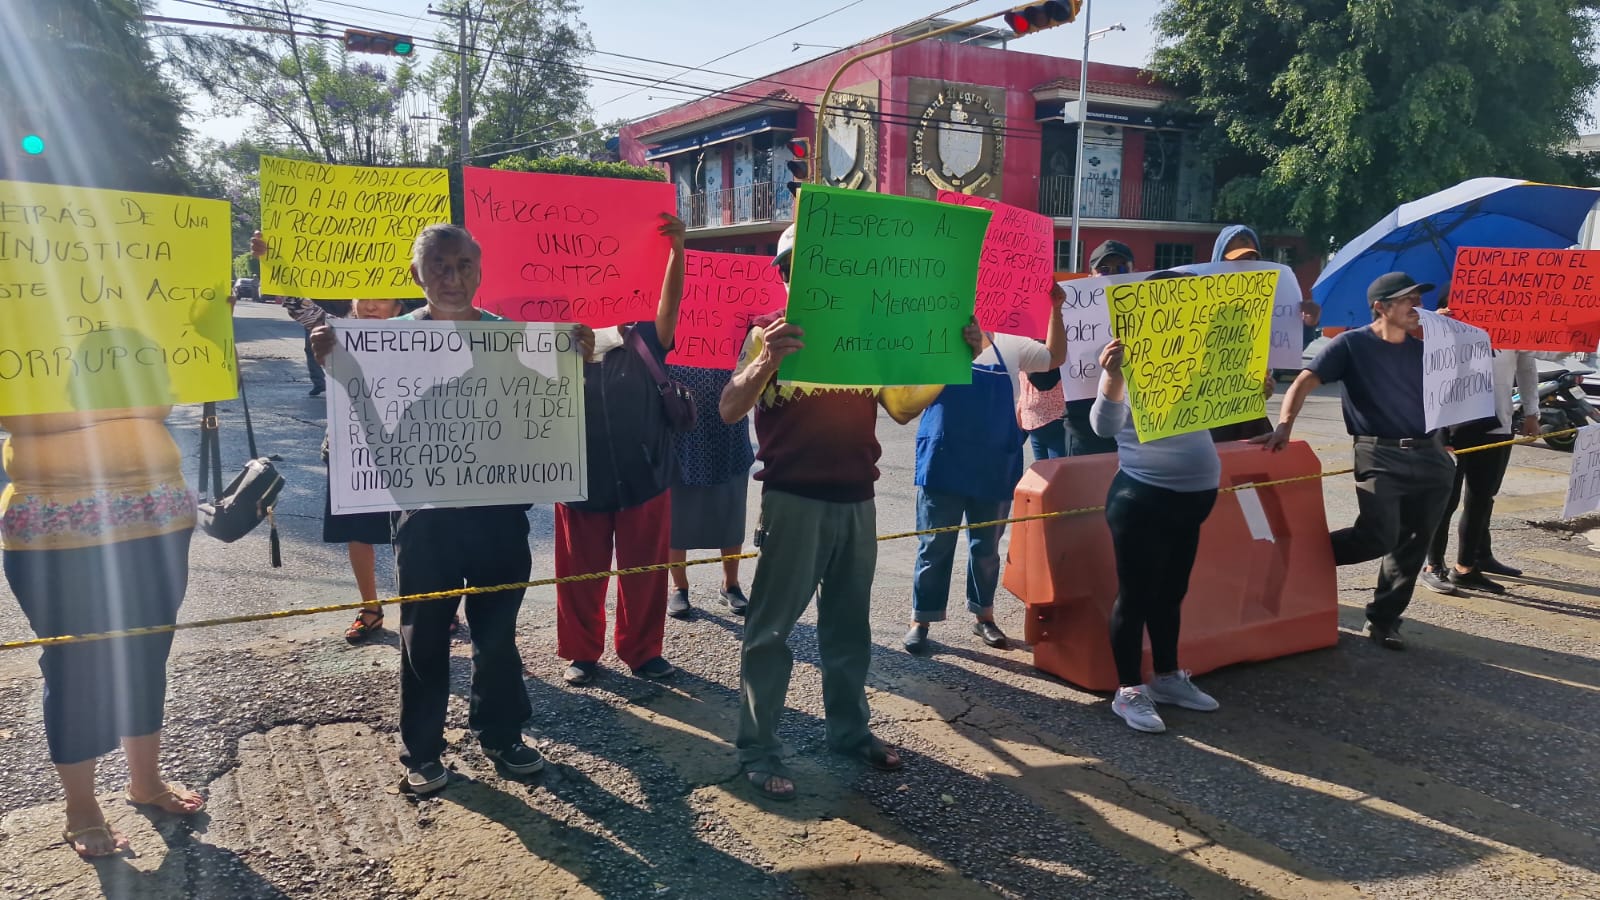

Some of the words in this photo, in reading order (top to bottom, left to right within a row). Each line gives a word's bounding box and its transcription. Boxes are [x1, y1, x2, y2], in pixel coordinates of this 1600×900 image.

[264, 180, 297, 207] ALTO
[308, 187, 322, 209] A
[327, 189, 348, 212] LA
[353, 189, 450, 215] CORRUPCION
[471, 186, 600, 226] MERCADO
[0, 201, 97, 229] ETRÁS
[115, 198, 155, 226] DE
[174, 203, 209, 230] UNA
[801, 191, 914, 239] RESPETO
[933, 212, 959, 240] AL
[0, 231, 171, 265] INJUSTICIA
[264, 236, 284, 261] AL
[536, 232, 621, 258] UNIDO
[986, 227, 1030, 251] LAMENTO
[683, 253, 785, 286] ERCADO
[800, 243, 946, 279] REGLAMENTO
[1000, 248, 1051, 275] RESPETO
[1457, 249, 1530, 268] CUMPLIR
[1536, 251, 1564, 267] CON
[1568, 252, 1588, 268] EL
[364, 266, 385, 288] YA
[388, 266, 412, 288] BA
[520, 262, 622, 286] CONTRA
[1200, 271, 1277, 301] REGIDORES
[1455, 268, 1566, 291] REGLAMENTO
[1571, 274, 1595, 291] DE
[0, 282, 48, 299] STE
[80, 275, 122, 304] UN
[146, 278, 217, 303] ACTO
[975, 290, 1006, 307] ENTO
[1010, 291, 1031, 310] DE
[1451, 289, 1533, 307] MERCADOS
[800, 287, 848, 312] DE
[870, 288, 961, 318] MERCADOS
[59, 315, 112, 337] DE
[679, 308, 723, 329] MAS
[974, 306, 1021, 328] CADOS
[1115, 310, 1146, 339] HAY
[1151, 307, 1185, 335] QUE
[1189, 300, 1228, 326] LEER
[1228, 296, 1270, 322] PARA
[1530, 310, 1541, 322] A
[1550, 310, 1568, 323] LA
[345, 330, 464, 353] MERCADO
[469, 331, 572, 354] HIDALGO
[673, 335, 745, 358] VENCI
[920, 327, 952, 355] 11
[1161, 334, 1185, 359] UN
[1482, 326, 1520, 346] IDAD
[1526, 328, 1596, 349] MUNICIPAL
[1068, 359, 1098, 380] de
[1137, 358, 1197, 390] SABER
[347, 376, 387, 400] QUE
[397, 376, 426, 398] SE
[432, 376, 489, 398] HAGA
[499, 376, 570, 397] VALER
[1168, 383, 1194, 405] DE
[1196, 370, 1263, 400] MERCADOS
[348, 400, 371, 422] EL
[385, 398, 498, 422] ARTICULO
[512, 400, 532, 420] 11
[539, 397, 577, 419] DEL
[1173, 405, 1200, 430] LOS
[348, 420, 503, 445] REGLAMENTO
[523, 419, 553, 440] DE
[351, 467, 415, 492] UNIDOS
[424, 465, 447, 488] VS
